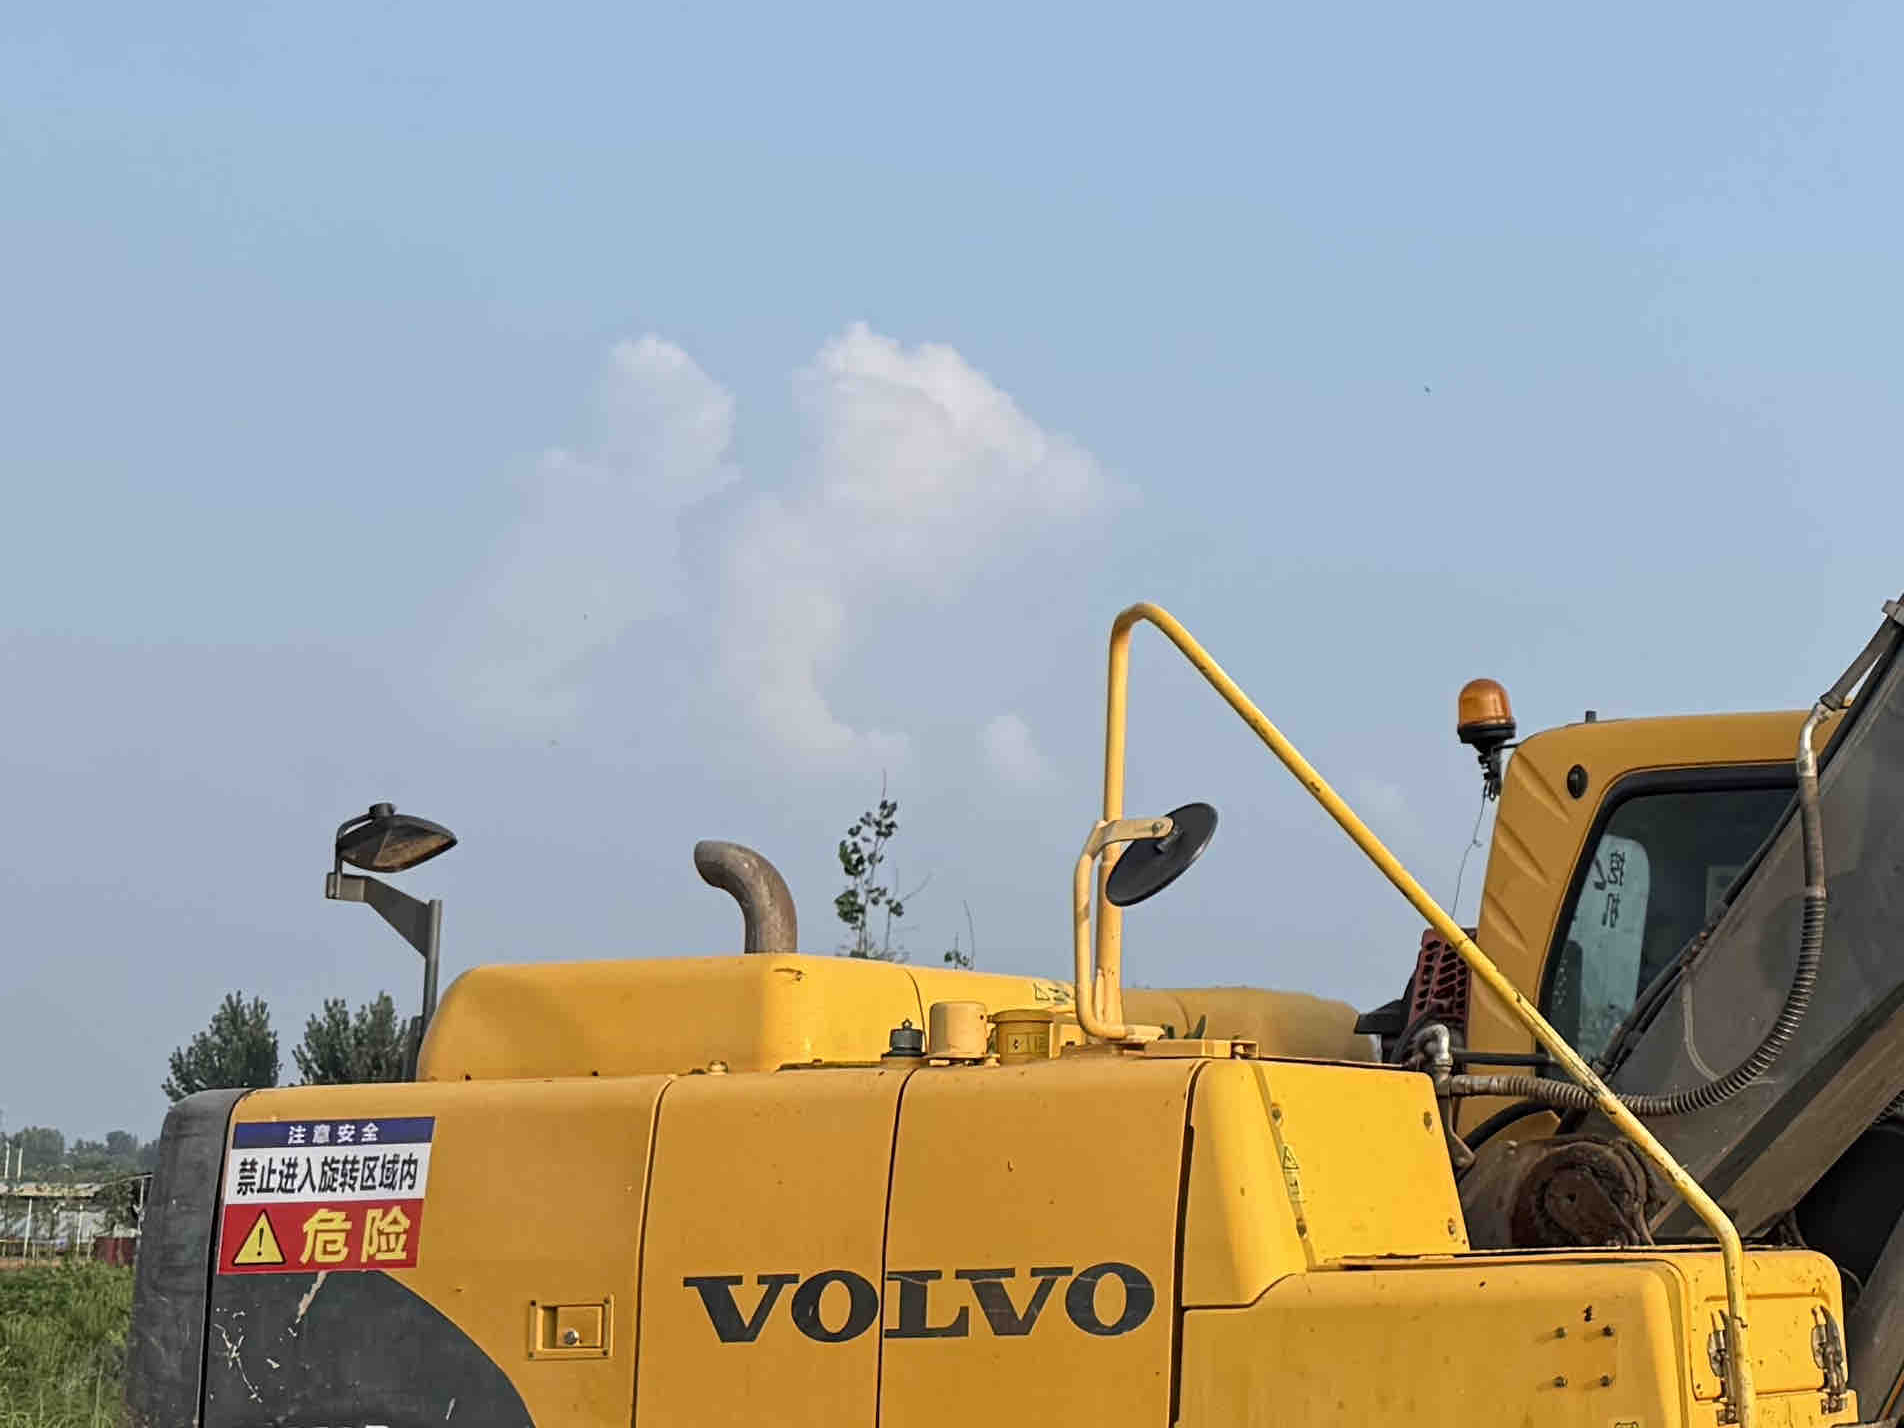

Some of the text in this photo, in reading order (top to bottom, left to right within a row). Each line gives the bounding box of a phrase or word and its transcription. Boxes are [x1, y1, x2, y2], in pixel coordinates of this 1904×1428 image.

[287, 1122, 379, 1145] 注意安全
[236, 1152, 418, 1196] 禁止进入旋转区域内
[299, 1205, 411, 1265] 危险
[683, 1262, 1155, 1344] VOLVO
